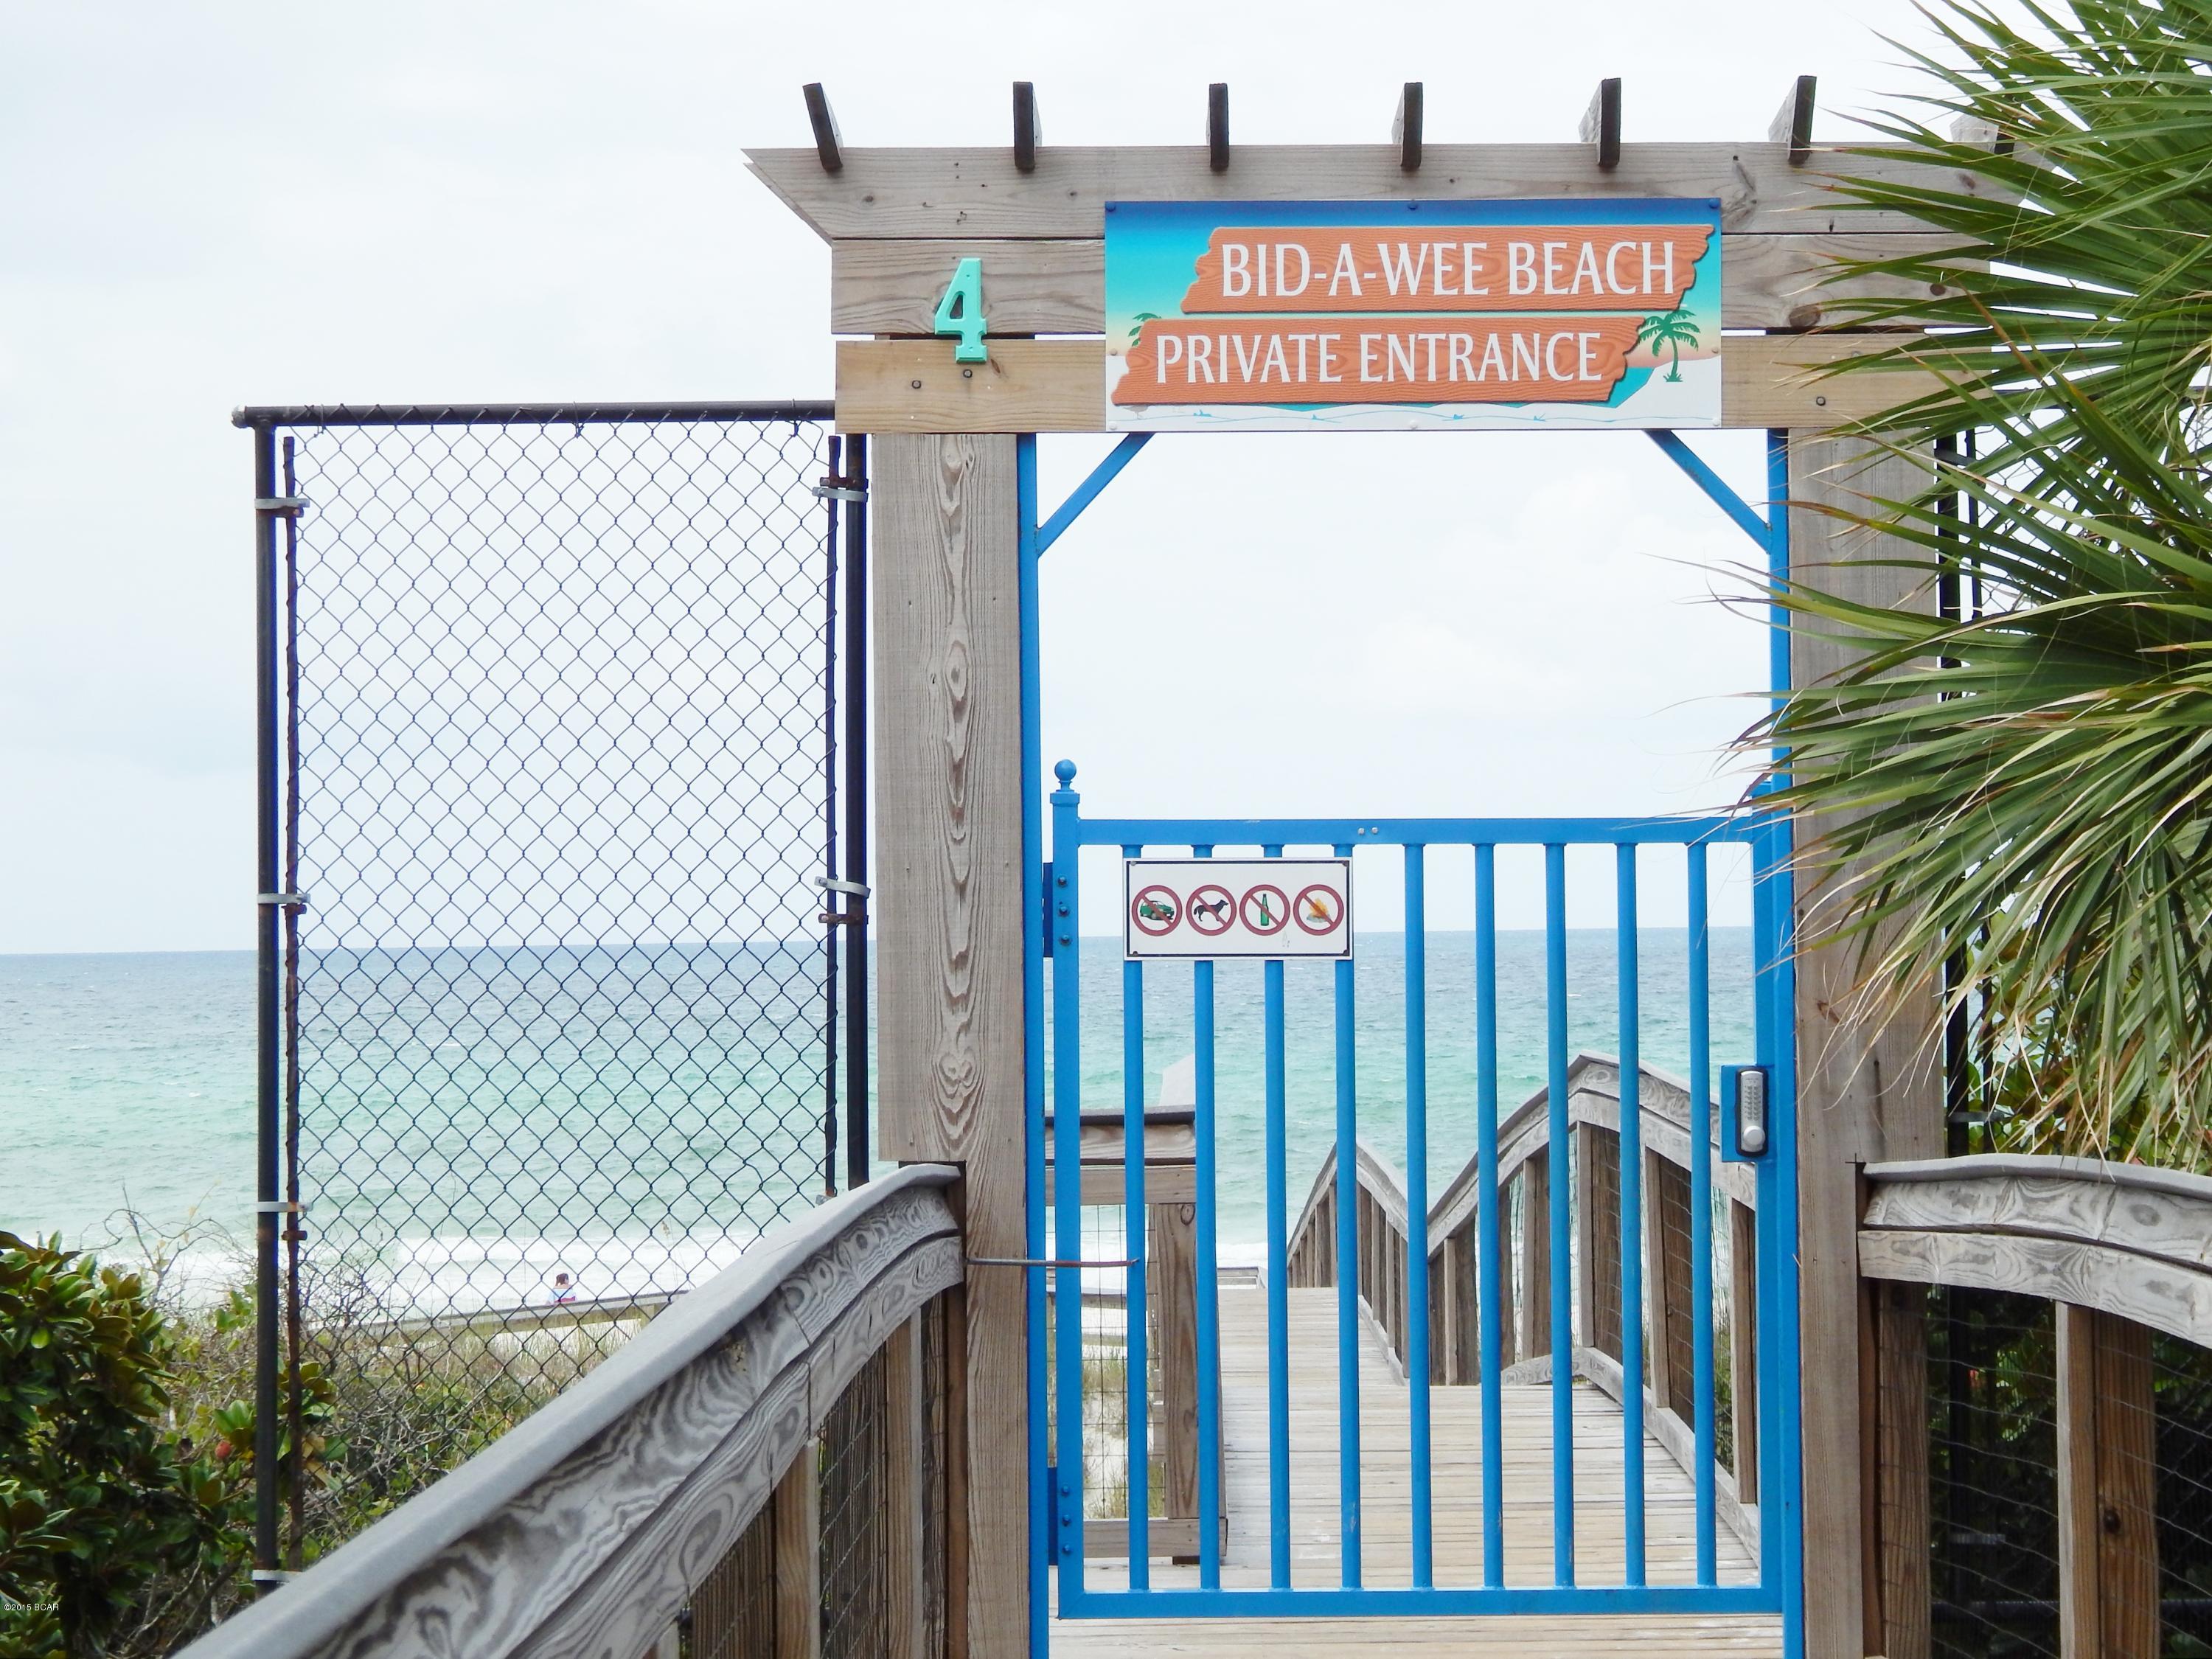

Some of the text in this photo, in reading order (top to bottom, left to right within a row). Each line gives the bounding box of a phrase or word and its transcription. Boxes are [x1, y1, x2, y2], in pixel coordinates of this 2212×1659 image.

[1221, 240, 1674, 298] BID-A-WEE BEACH
[934, 257, 988, 361] 4
[1155, 332, 1603, 384] PRIVATE ENTRANCE
